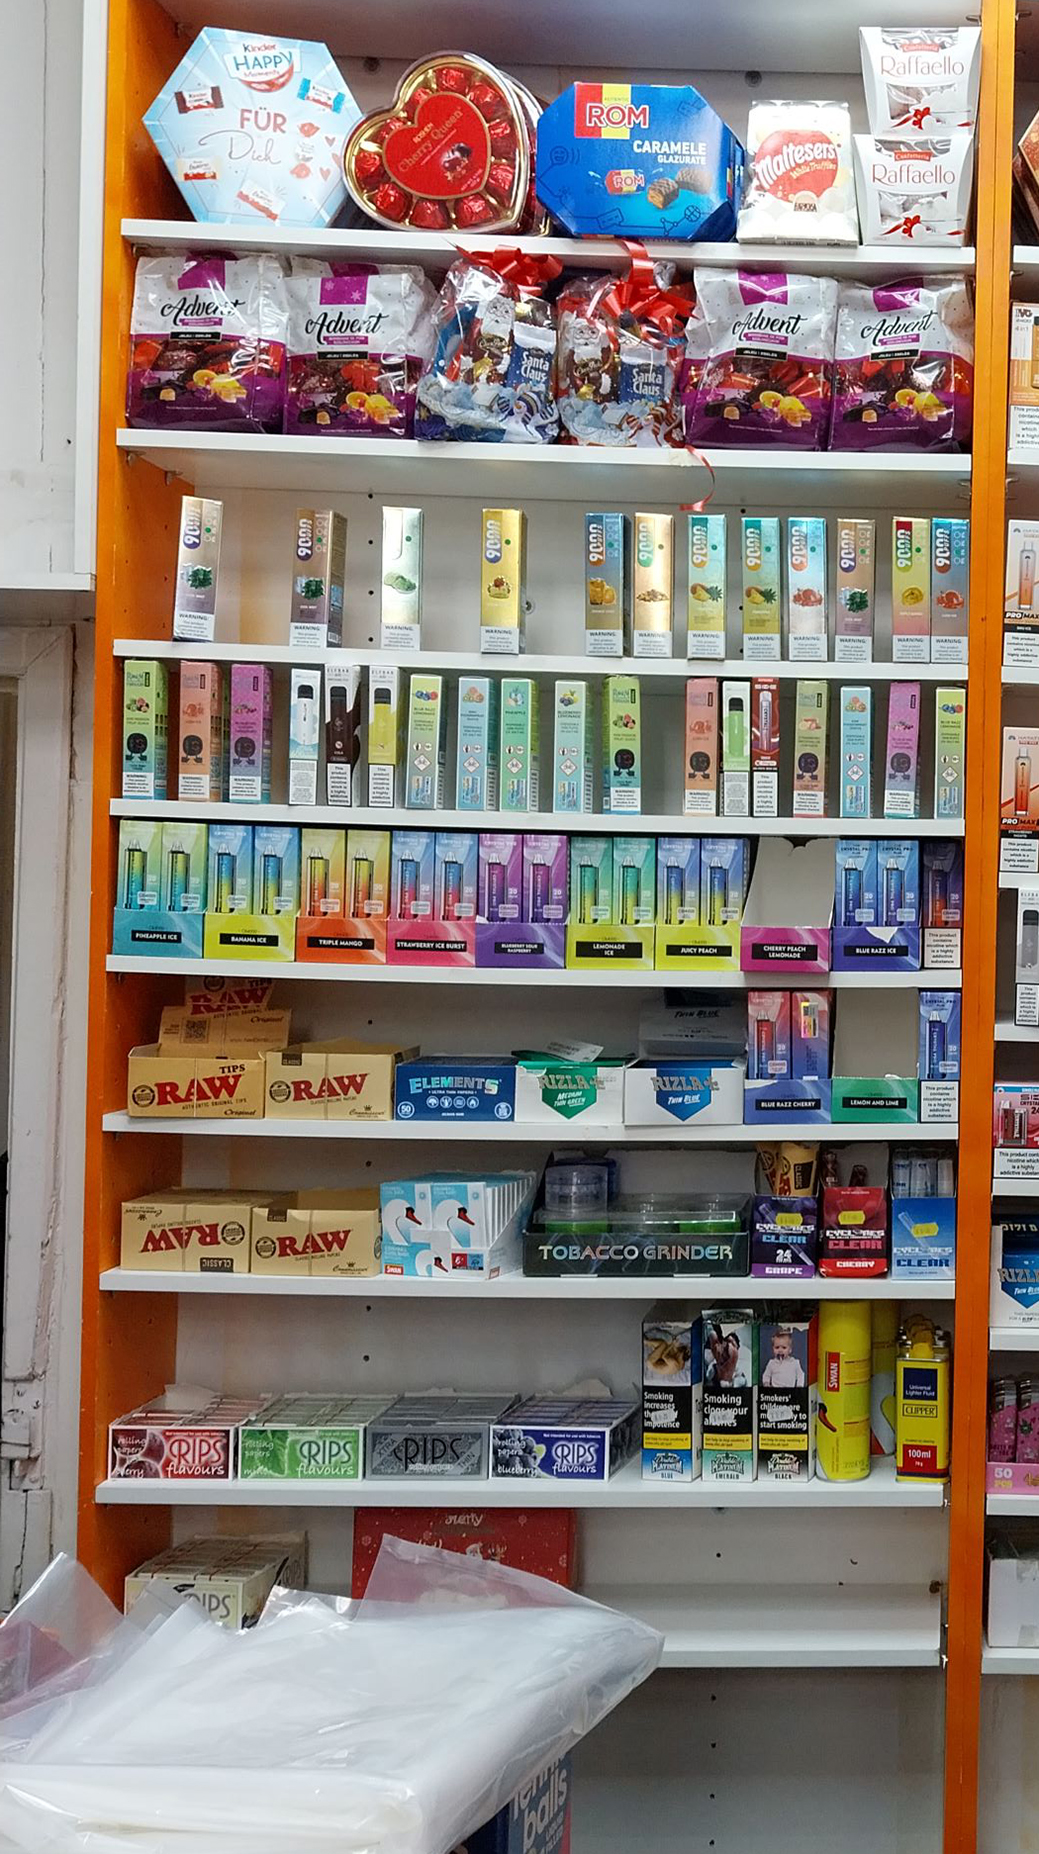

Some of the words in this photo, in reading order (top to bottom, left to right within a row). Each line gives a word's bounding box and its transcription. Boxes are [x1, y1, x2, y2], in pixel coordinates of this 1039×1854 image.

[233, 51, 293, 71] HAPPY
[880, 56, 965, 77] Raffaello
[239, 107, 287, 134] FÜR
[586, 103, 650, 129] ROM
[199, 129, 281, 166] Dich
[397, 135, 431, 172] Cherry
[430, 109, 464, 142] Queen
[632, 140, 708, 157] CARAMELE
[656, 154, 707, 166] GLAZURATE
[755, 142, 836, 190] Maltesers
[613, 173, 645, 188] ROM
[872, 164, 956, 186] Raffaello
[160, 296, 246, 327] Advent
[304, 311, 389, 348] Advent
[732, 308, 807, 347] Advent
[859, 310, 938, 347] Advent
[520, 352, 550, 371] Santa
[520, 364, 549, 383] Claus
[631, 367, 663, 387] Santa
[631, 380, 661, 396] Claus
[1004, 611, 1023, 621] PRO
[1002, 817, 1019, 826] PRO
[1020, 818, 1037, 827] MAX
[135, 931, 169, 941] PINEAPPLE
[168, 932, 178, 941] ICE
[230, 936, 256, 944] BANANA
[256, 936, 267, 944] ICE
[318, 938, 339, 947] TRIPLE
[339, 939, 363, 947] MANGO
[396, 940, 434, 950] STRAWBERRY
[434, 941, 446, 950] ICE
[446, 941, 466, 951] BURST
[592, 943, 626, 951] LEMONADE
[604, 949, 615, 957] ICE
[680, 946, 697, 955] JUICY
[698, 946, 718, 955] PEACH
[763, 945, 785, 953] CHERRY
[786, 945, 806, 953] PEACH
[768, 951, 801, 960] LEMONADE
[190, 986, 270, 1016] RAW
[219, 1063, 246, 1075] TIPS
[154, 1074, 243, 1106] RAW
[291, 1073, 369, 1100] RAW
[409, 1076, 501, 1095] ELEMENTS
[537, 1074, 591, 1091] RIZLA
[650, 1076, 704, 1092] RIZLA
[760, 1100, 775, 1109] BLUE
[775, 1100, 791, 1109] RAZZ
[792, 1099, 816, 1109] CHERRY
[850, 1098, 872, 1107] LEMON
[872, 1098, 884, 1107] AND
[884, 1098, 899, 1107] LIME
[224, 1108, 257, 1117] Original
[140, 1222, 221, 1254] RAW
[276, 1229, 352, 1258] RAW
[828, 1239, 883, 1250] CLEAR
[538, 1245, 639, 1261] TOBACCO
[643, 1245, 734, 1261] GRINDER
[776, 1249, 792, 1258] 24
[201, 1257, 233, 1271] CLASSIC
[765, 1266, 803, 1275] GRAPE
[836, 1260, 876, 1269] CHERRY
[896, 1258, 950, 1268] CLEAR
[828, 1359, 838, 1391] SWAN
[908, 1384, 932, 1392] Universal
[643, 1391, 674, 1403] Smoking
[703, 1393, 742, 1406] Smoking
[760, 1393, 792, 1402] Smokers'
[643, 1402, 676, 1410] increases
[905, 1406, 936, 1416] CLIPPER
[760, 1421, 776, 1430] start
[777, 1421, 808, 1431] smoking
[169, 1438, 224, 1465] RIPS
[299, 1439, 353, 1466] RIPS
[393, 1437, 462, 1472] RIPS
[553, 1441, 599, 1464] RIPS
[907, 1449, 931, 1459] 100ml
[166, 1463, 226, 1478] flavours
[296, 1463, 355, 1478] flavours
[497, 1464, 539, 1477] blueberry
[551, 1463, 598, 1475] flavours
[523, 1768, 568, 1850] balls
